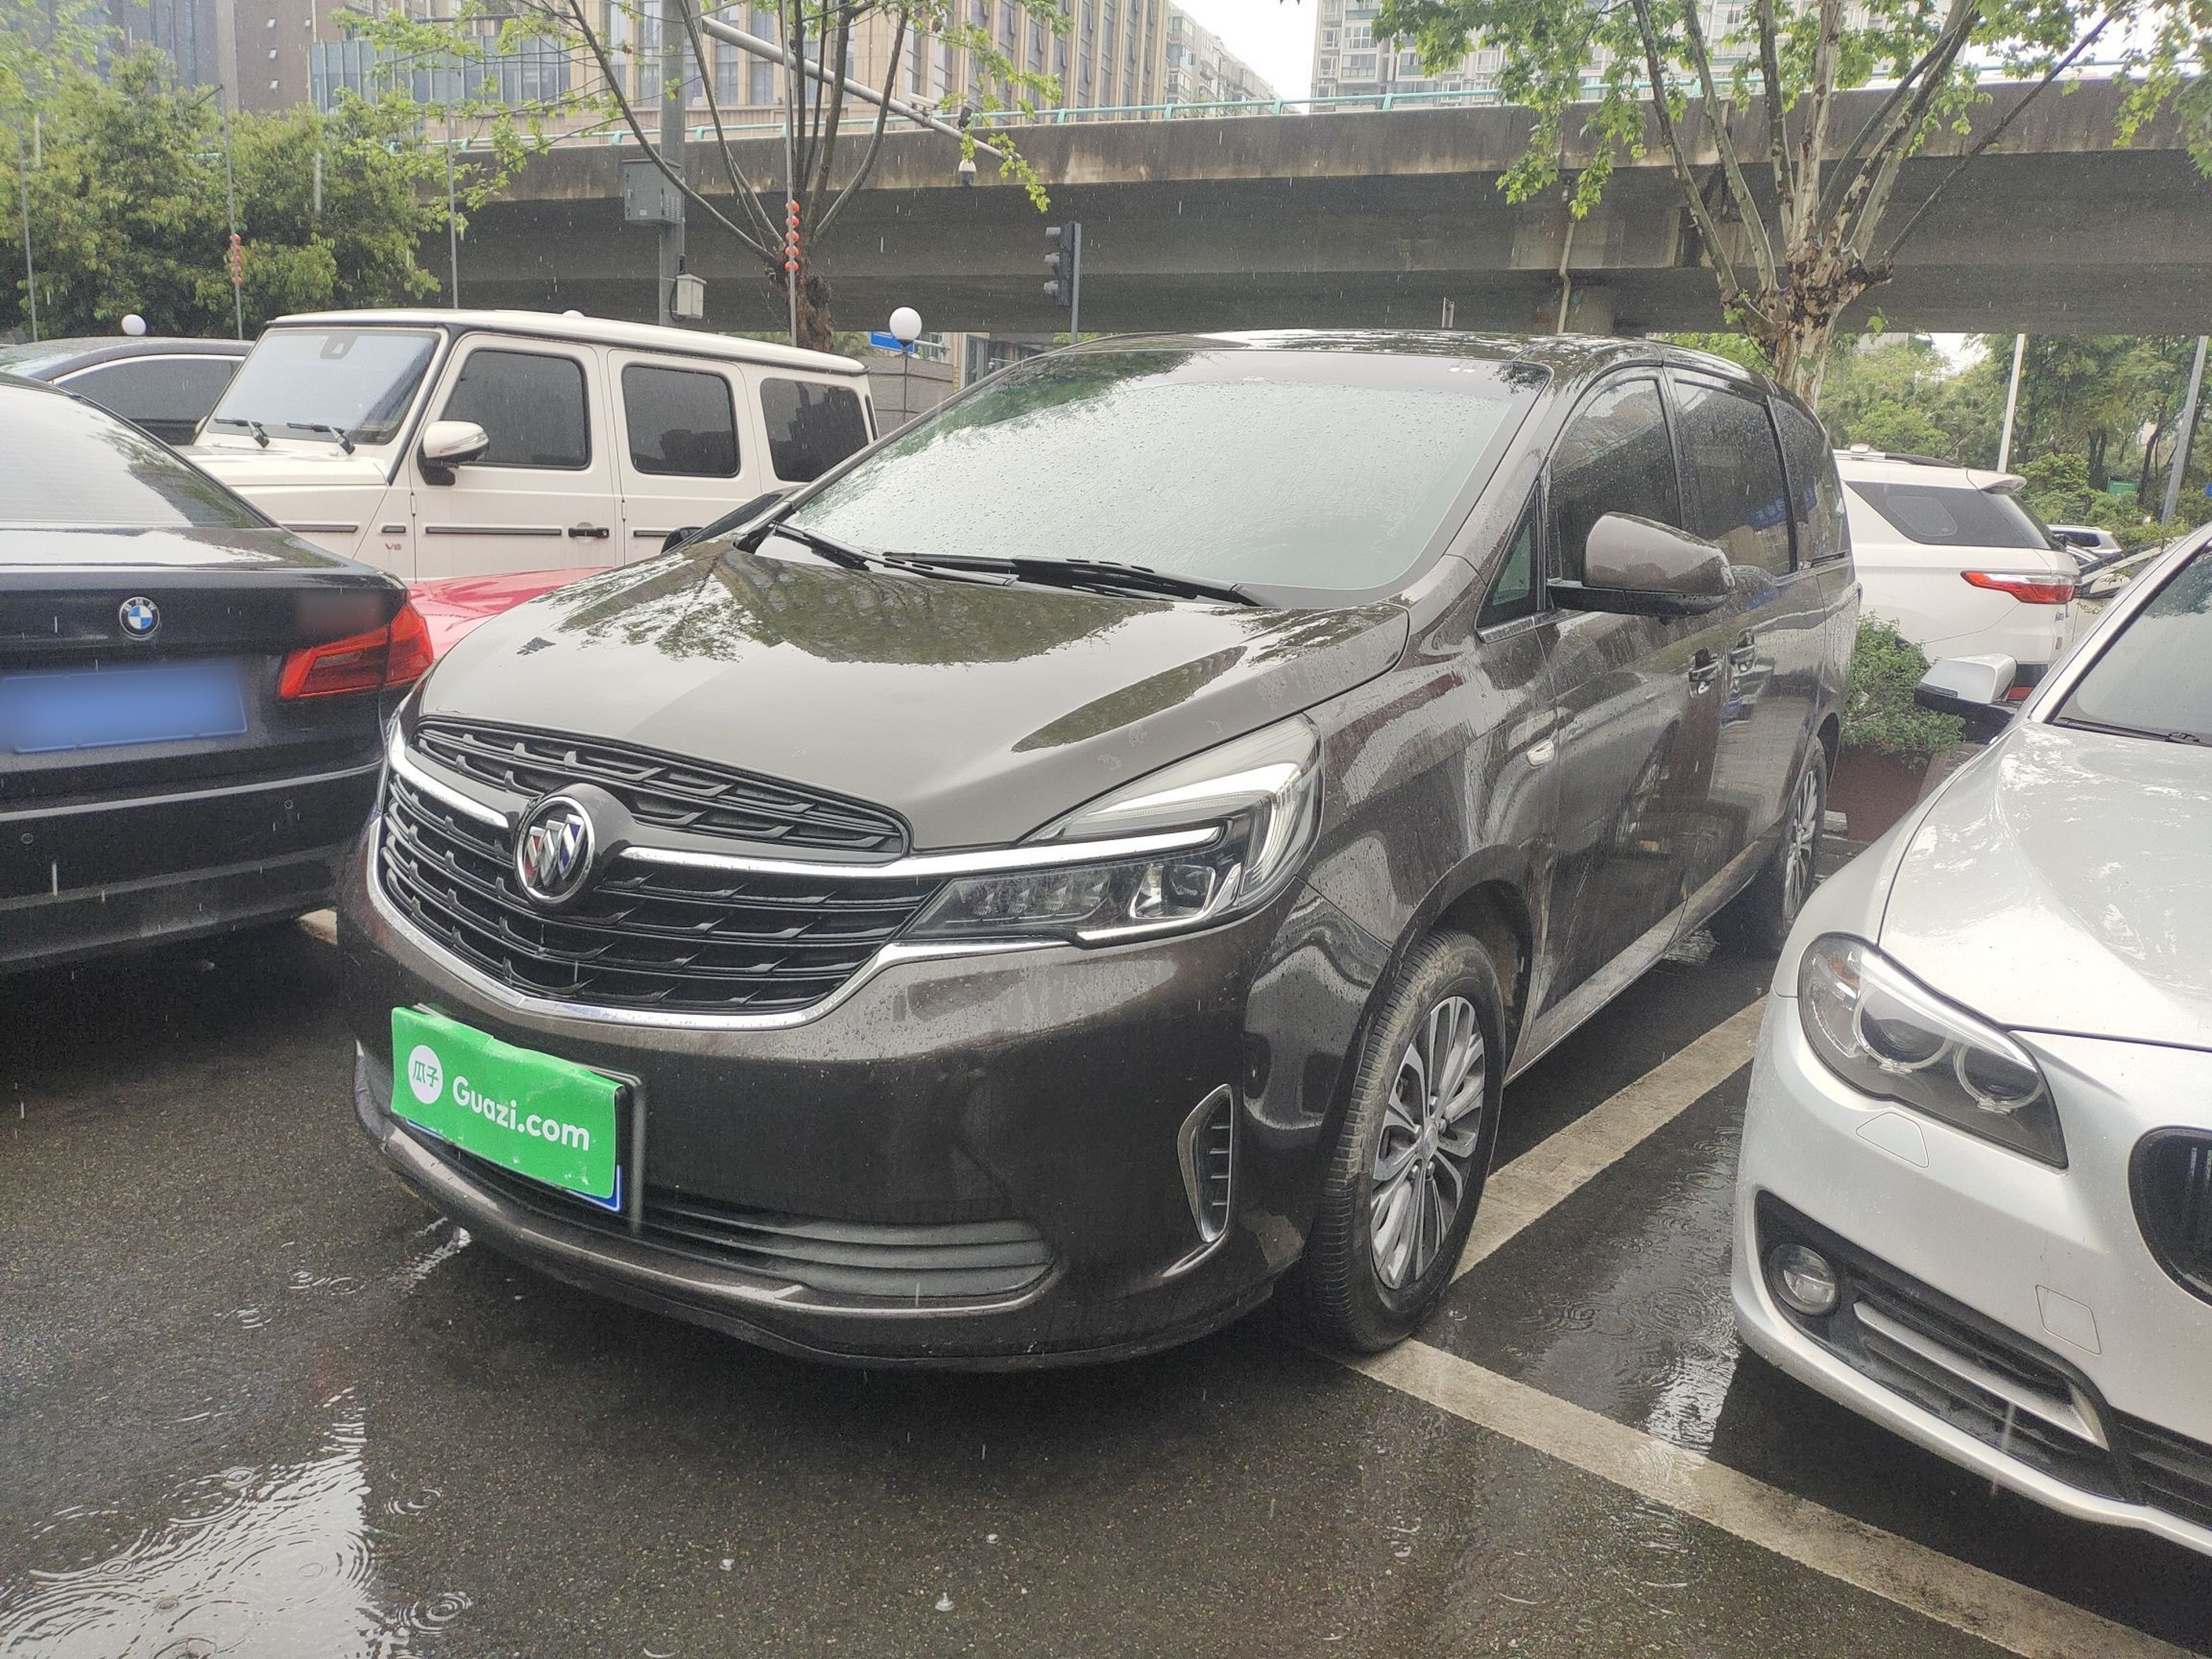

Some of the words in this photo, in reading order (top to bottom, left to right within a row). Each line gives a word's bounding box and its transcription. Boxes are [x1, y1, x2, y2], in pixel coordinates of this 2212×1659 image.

[124, 599, 156, 611] BMW
[412, 1060, 439, 1088] 瓜子
[452, 1075, 590, 1151] Guazi.com
